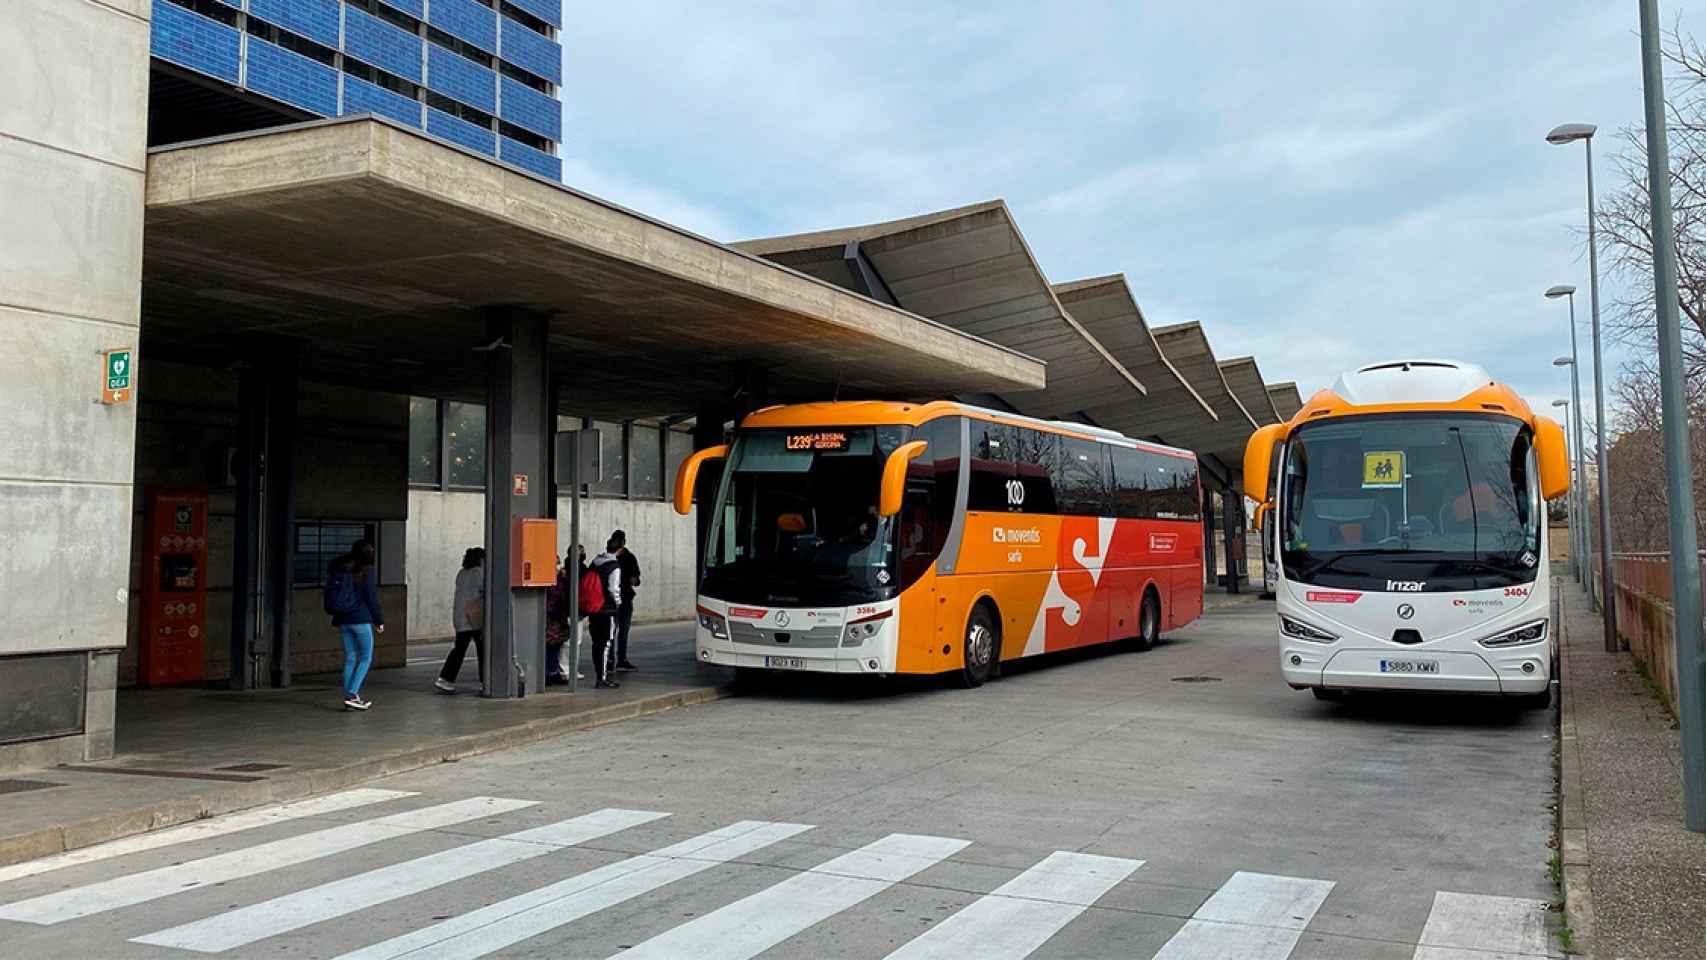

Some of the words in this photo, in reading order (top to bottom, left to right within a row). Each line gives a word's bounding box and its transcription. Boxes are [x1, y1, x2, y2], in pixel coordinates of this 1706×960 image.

[110, 379, 127, 388] DEA
[786, 435, 811, 449] L239
[1006, 479, 1025, 505] 100
[1386, 579, 1426, 591] Irizar
[1504, 588, 1528, 597] 3404
[1388, 661, 1412, 671] 5880
